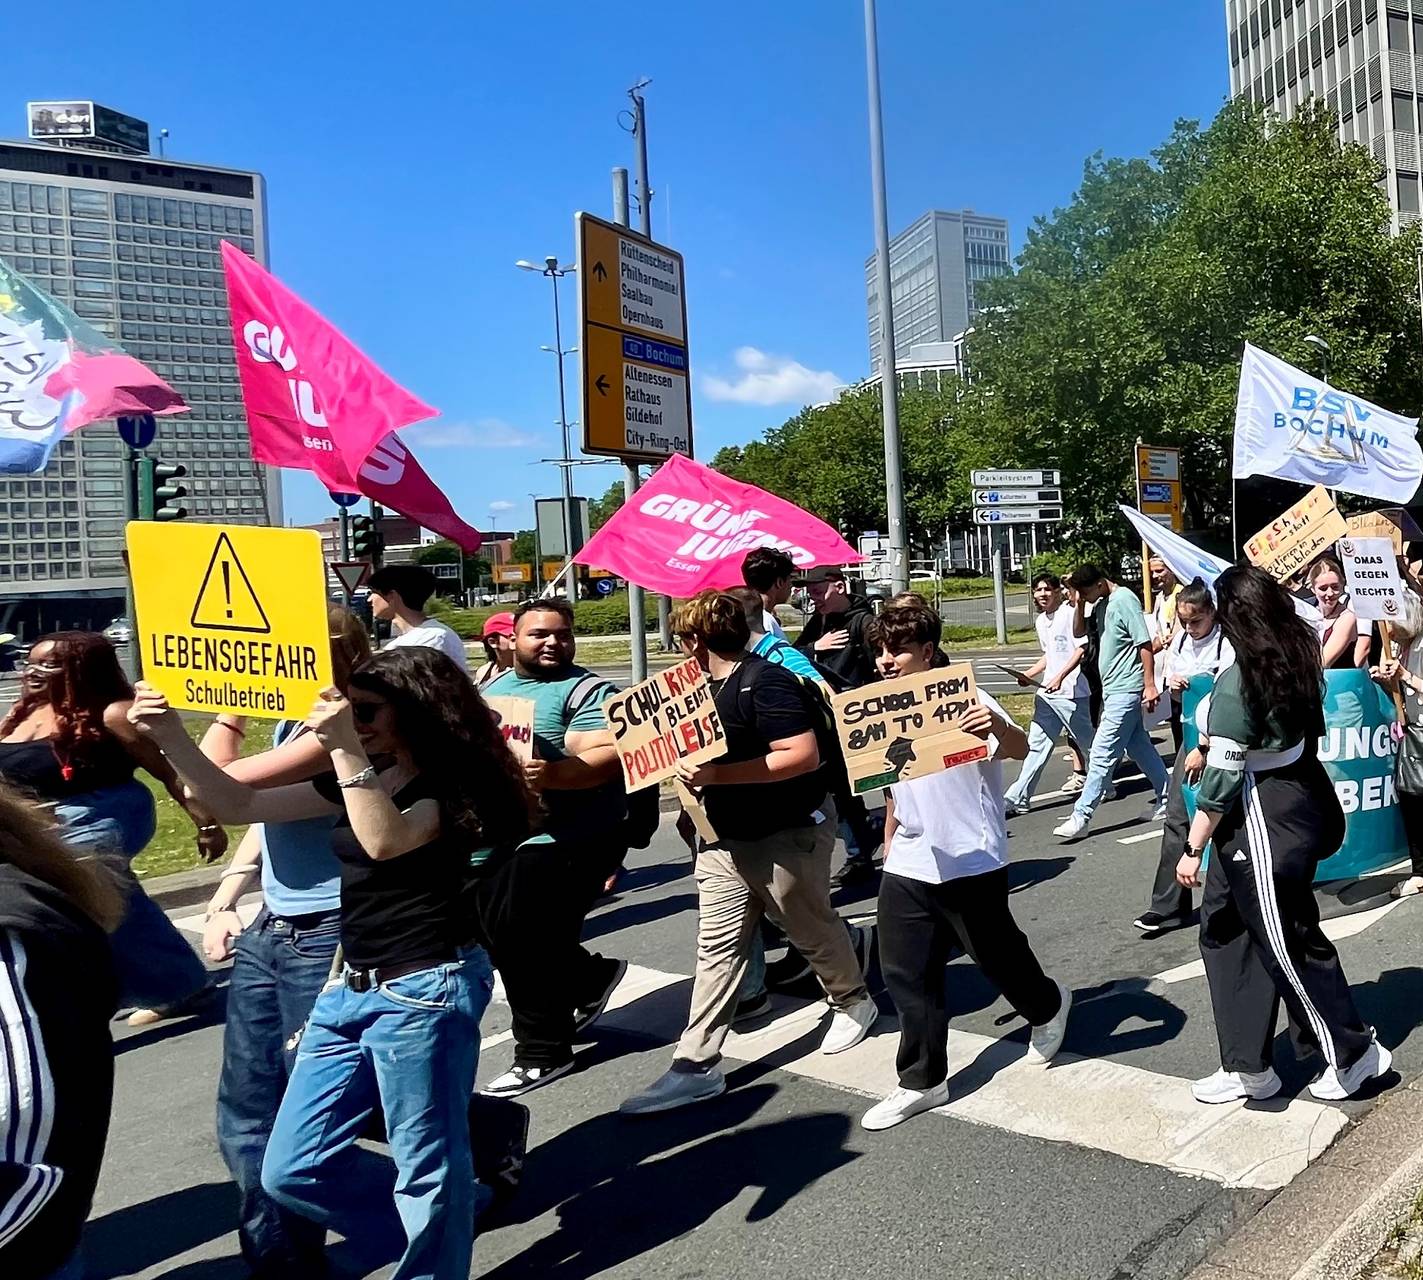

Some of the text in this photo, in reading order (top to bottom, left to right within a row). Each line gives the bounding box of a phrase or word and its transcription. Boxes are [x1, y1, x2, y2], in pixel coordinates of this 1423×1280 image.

[621, 240, 674, 275] Rüttenscheid
[622, 283, 653, 306] Saalbau
[622, 304, 664, 330] Opernhaus
[646, 344, 684, 367] Bochum
[625, 364, 673, 389] Altenessen
[625, 385, 661, 406] Rathaus
[1291, 386, 1372, 422] BSV
[626, 406, 663, 426] Gildehof
[626, 429, 688, 452] City-Ring-Ost
[1274, 412, 1389, 449] BOCHUM
[639, 493, 772, 537] GRÜNE
[666, 557, 701, 573] Essen
[1354, 556, 1384, 565] OMAS
[1354, 570, 1389, 579] GEGEN
[1355, 587, 1395, 597] RECHTS
[152, 633, 318, 681] LEBENSGEFAHR
[185, 678, 285, 712] Schulbetrieb
[843, 676, 969, 725] SCHOOL FROM
[671, 710, 723, 759] LEISE
[847, 720, 887, 749] 8AM
[892, 712, 924, 733] TO
